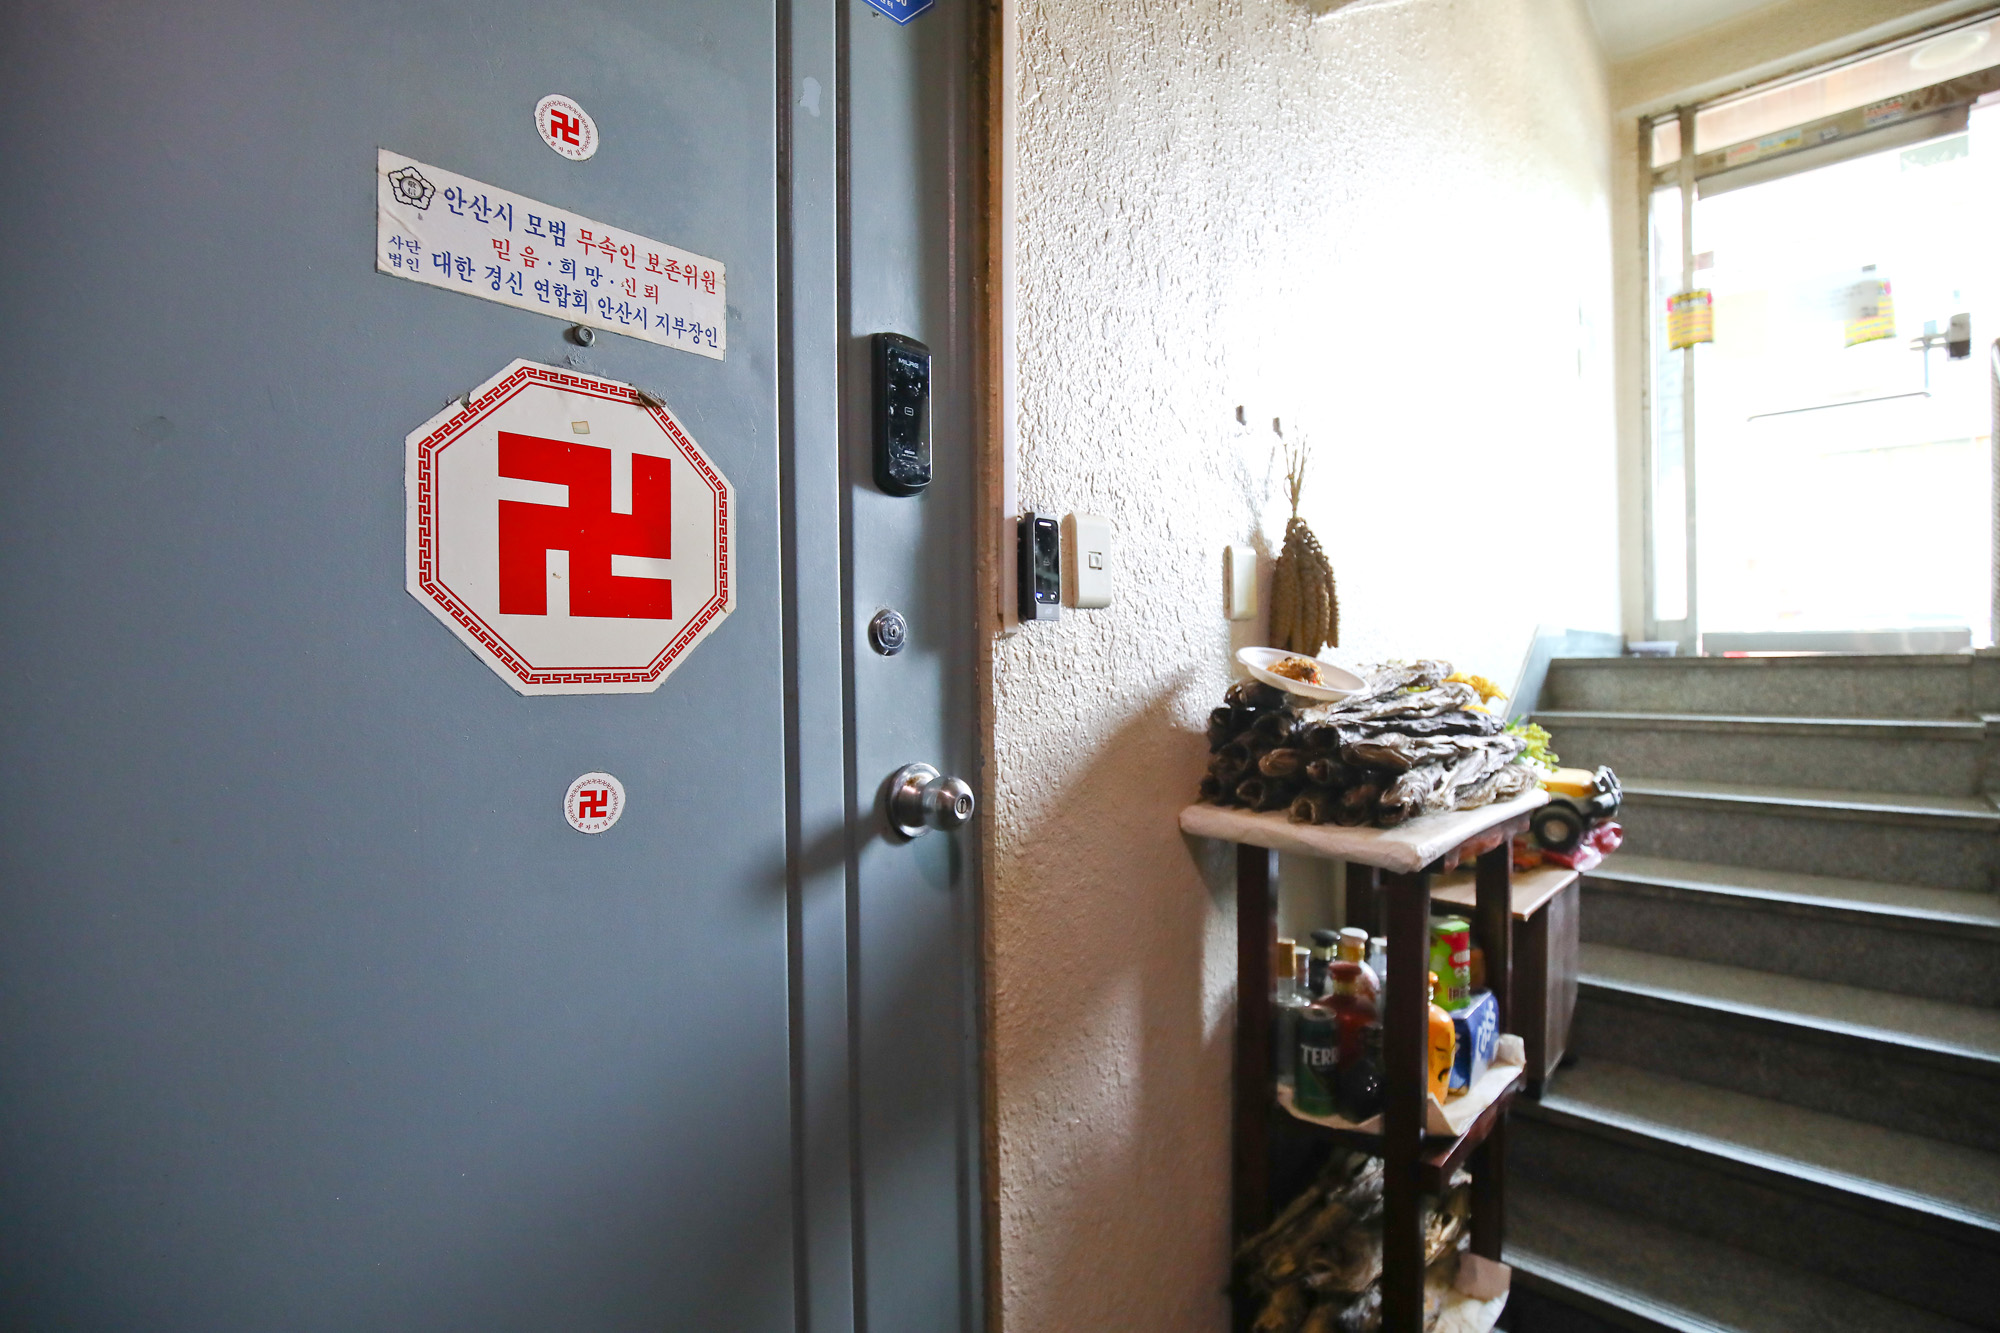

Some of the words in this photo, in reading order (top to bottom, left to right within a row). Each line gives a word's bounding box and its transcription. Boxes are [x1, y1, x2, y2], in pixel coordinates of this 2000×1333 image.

[388, 235, 421, 255] 사단
[388, 252, 420, 273] 법인
[444, 186, 513, 232] 안산시
[524, 213, 566, 247] 모범
[576, 228, 636, 270] 무속인
[645, 253, 716, 295] 보존위원
[432, 250, 476, 283] 대한
[484, 265, 523, 297] 경신
[534, 278, 588, 314] 연합회
[598, 296, 648, 330] 안산시
[655, 313, 718, 349] 지부장인
